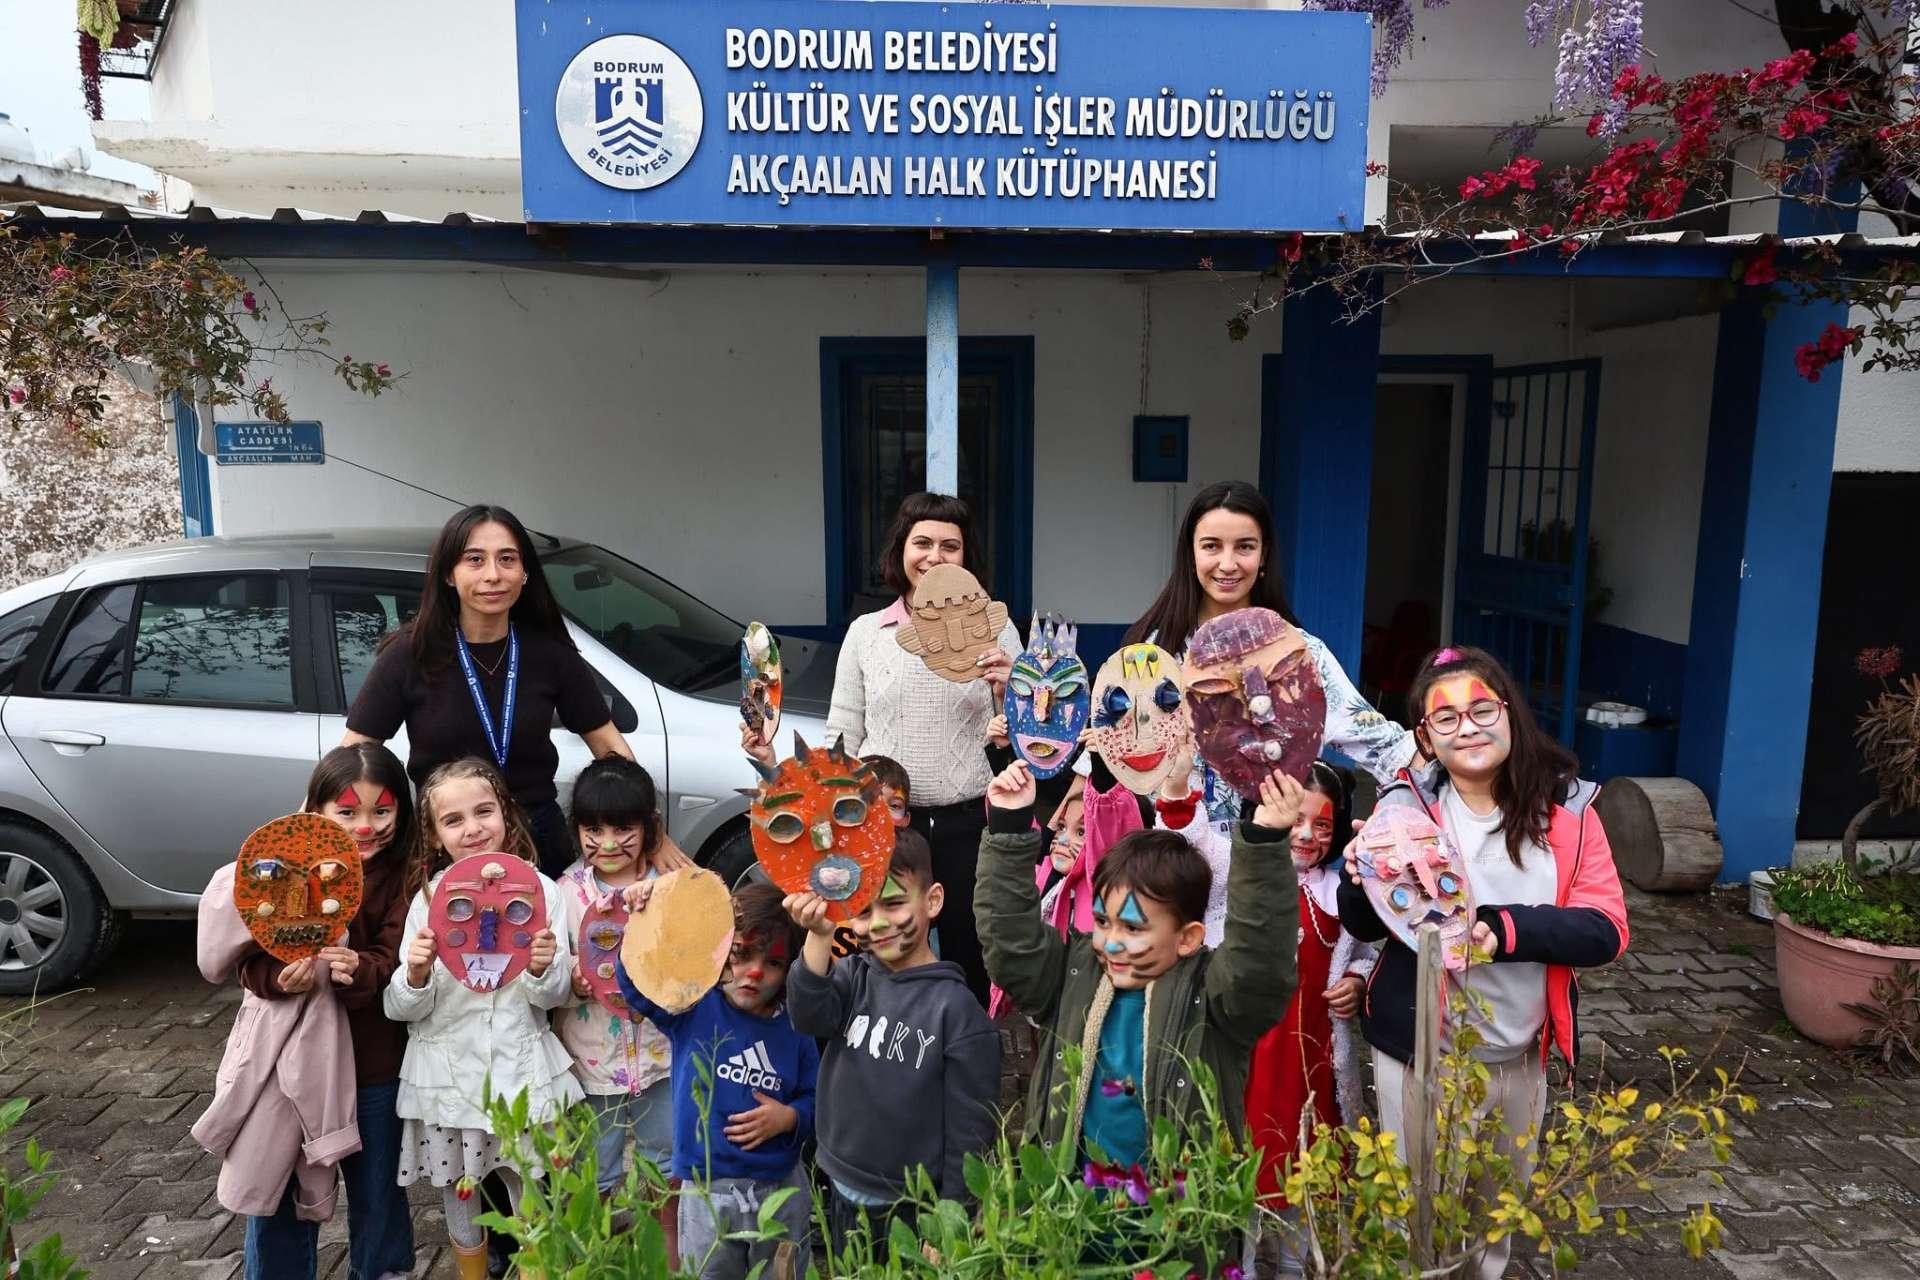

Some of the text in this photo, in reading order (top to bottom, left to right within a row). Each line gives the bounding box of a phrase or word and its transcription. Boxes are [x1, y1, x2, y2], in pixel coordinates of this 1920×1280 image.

[725, 20, 1057, 73] BODRUM BELEDİYESİ
[594, 61, 664, 74] BODRUM
[727, 81, 1336, 147] KÜLTÜR VE SOSYAL İŞLER MÜDÜRLÜĞÜ
[586, 147, 673, 177] BELEDİYESİ
[726, 147, 1217, 205] AKÇAALAN HALK KÜTÜPHANESİ
[717, 1064, 782, 1091] adidas
